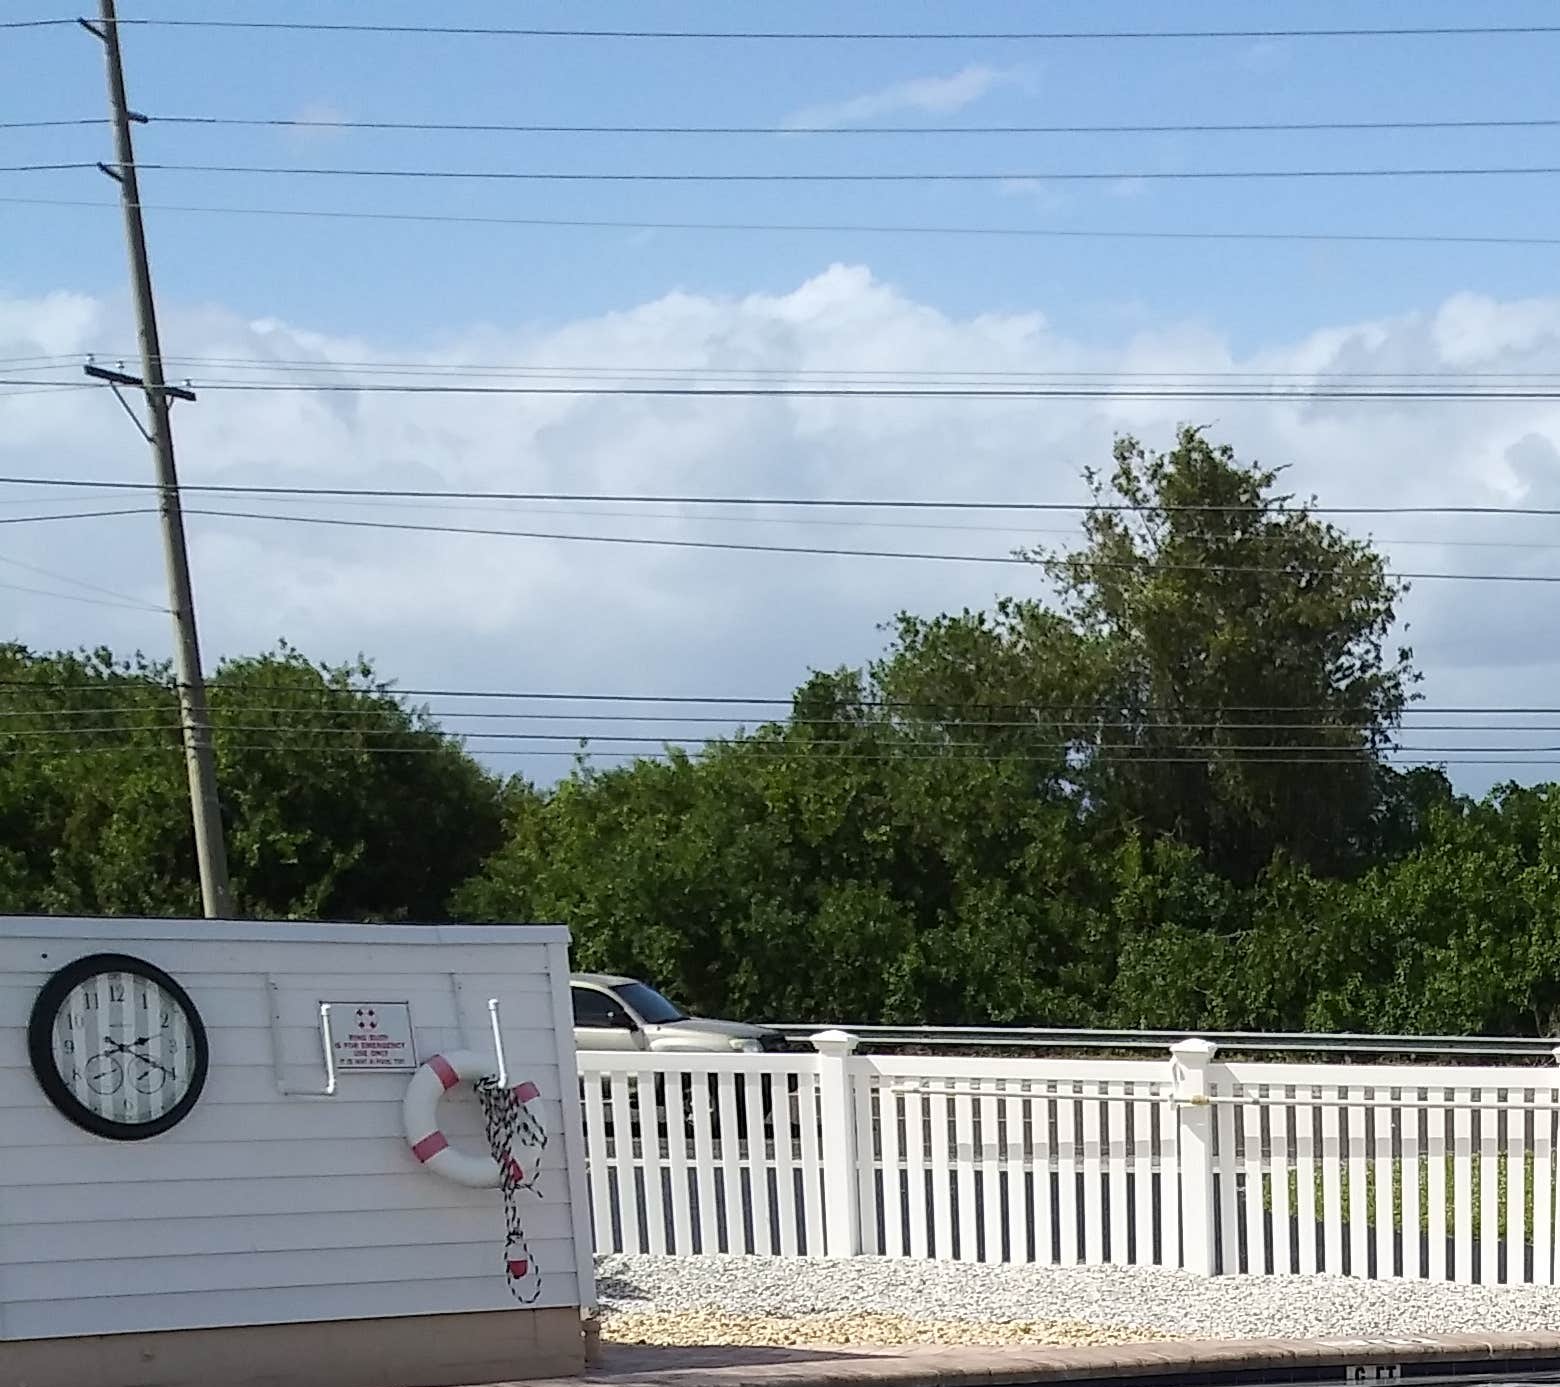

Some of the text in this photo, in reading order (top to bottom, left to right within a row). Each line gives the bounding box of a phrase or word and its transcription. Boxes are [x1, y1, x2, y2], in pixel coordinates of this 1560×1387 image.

[84, 992, 99, 1010] 11
[109, 985, 125, 1002] 12
[141, 992, 148, 1010] 1
[160, 1013, 169, 1029] 2
